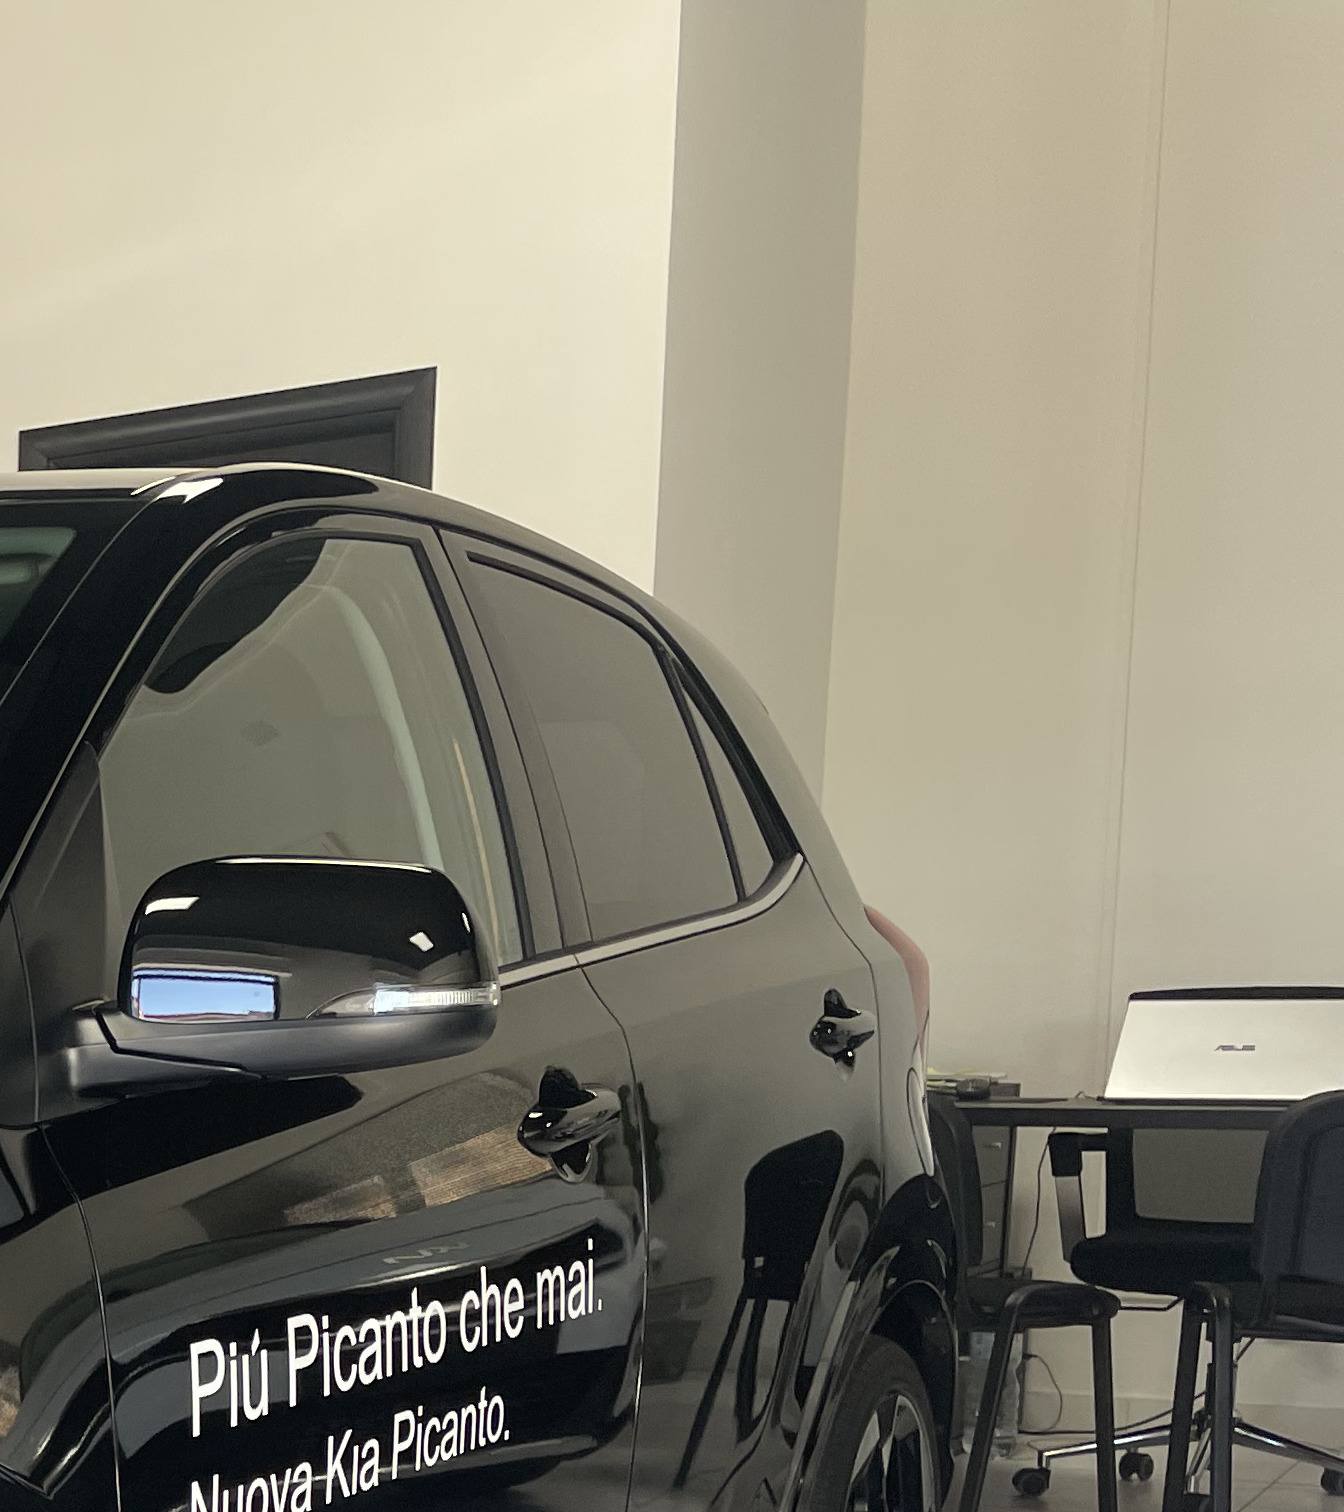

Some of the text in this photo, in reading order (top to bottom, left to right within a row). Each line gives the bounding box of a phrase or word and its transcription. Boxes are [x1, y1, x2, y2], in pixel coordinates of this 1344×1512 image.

[287, 1286, 449, 1408] Picanto
[459, 1265, 525, 1352] che
[536, 1238, 603, 1329] mai.
[391, 1386, 511, 1480] Picanto.
